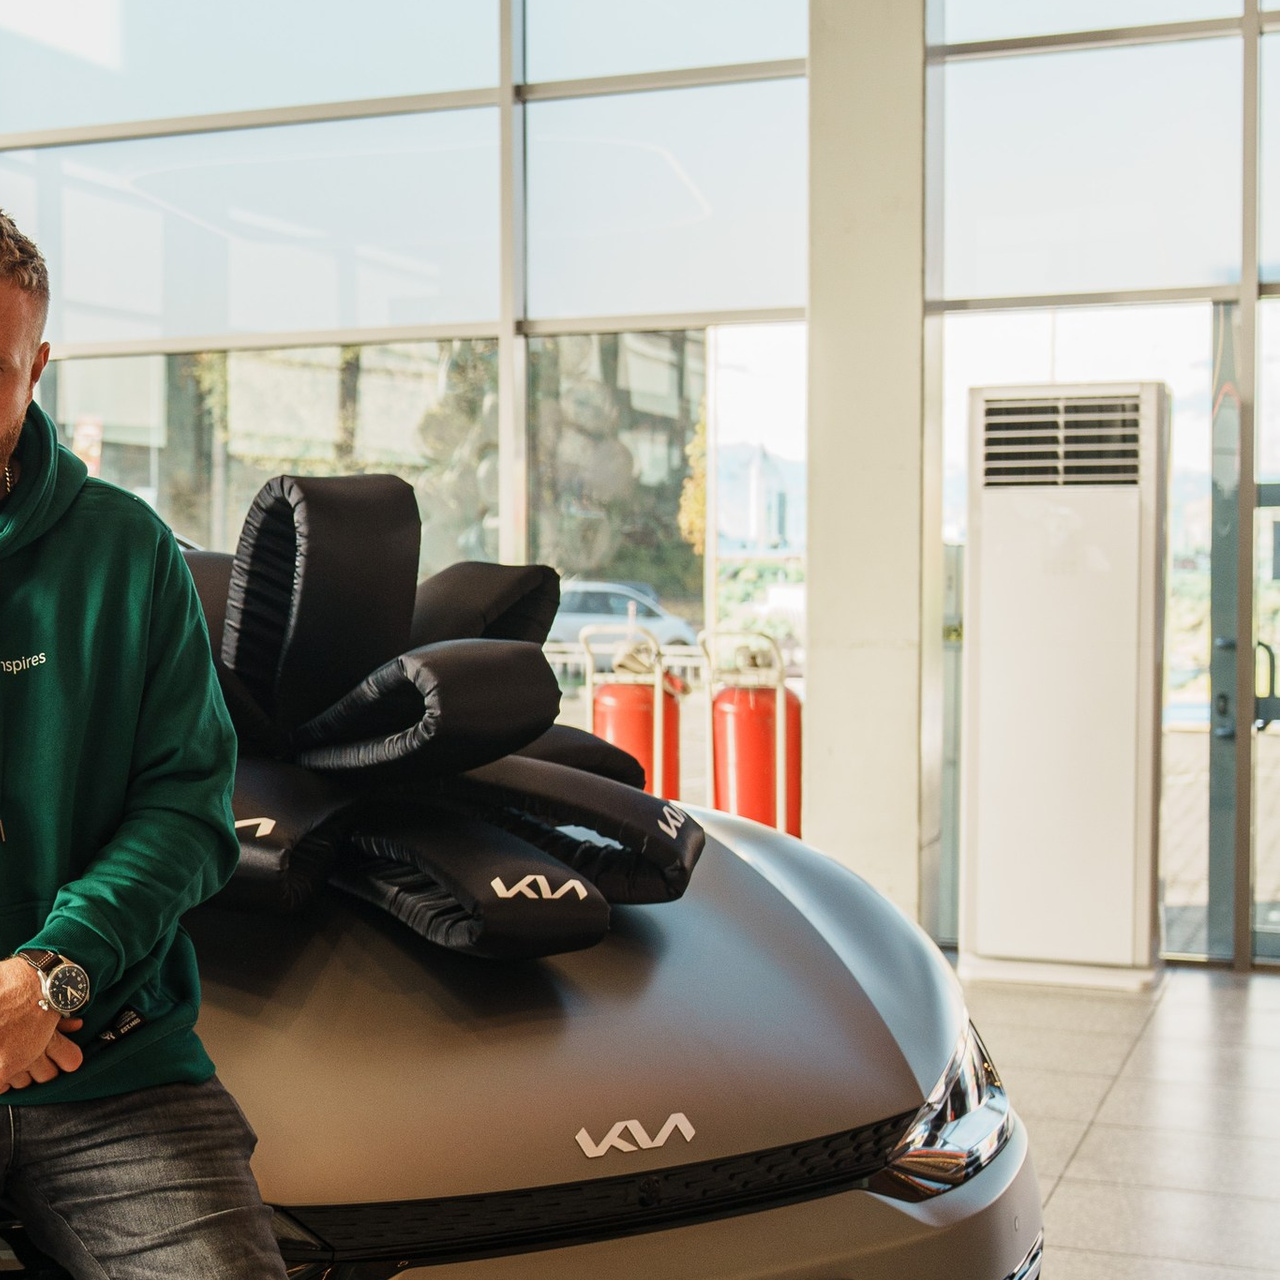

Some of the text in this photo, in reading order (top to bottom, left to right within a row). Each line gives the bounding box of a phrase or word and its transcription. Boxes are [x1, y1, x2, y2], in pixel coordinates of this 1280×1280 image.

[0, 652, 47, 675] nspires
[489, 874, 588, 901] KIA
[574, 1112, 696, 1158] KIA
